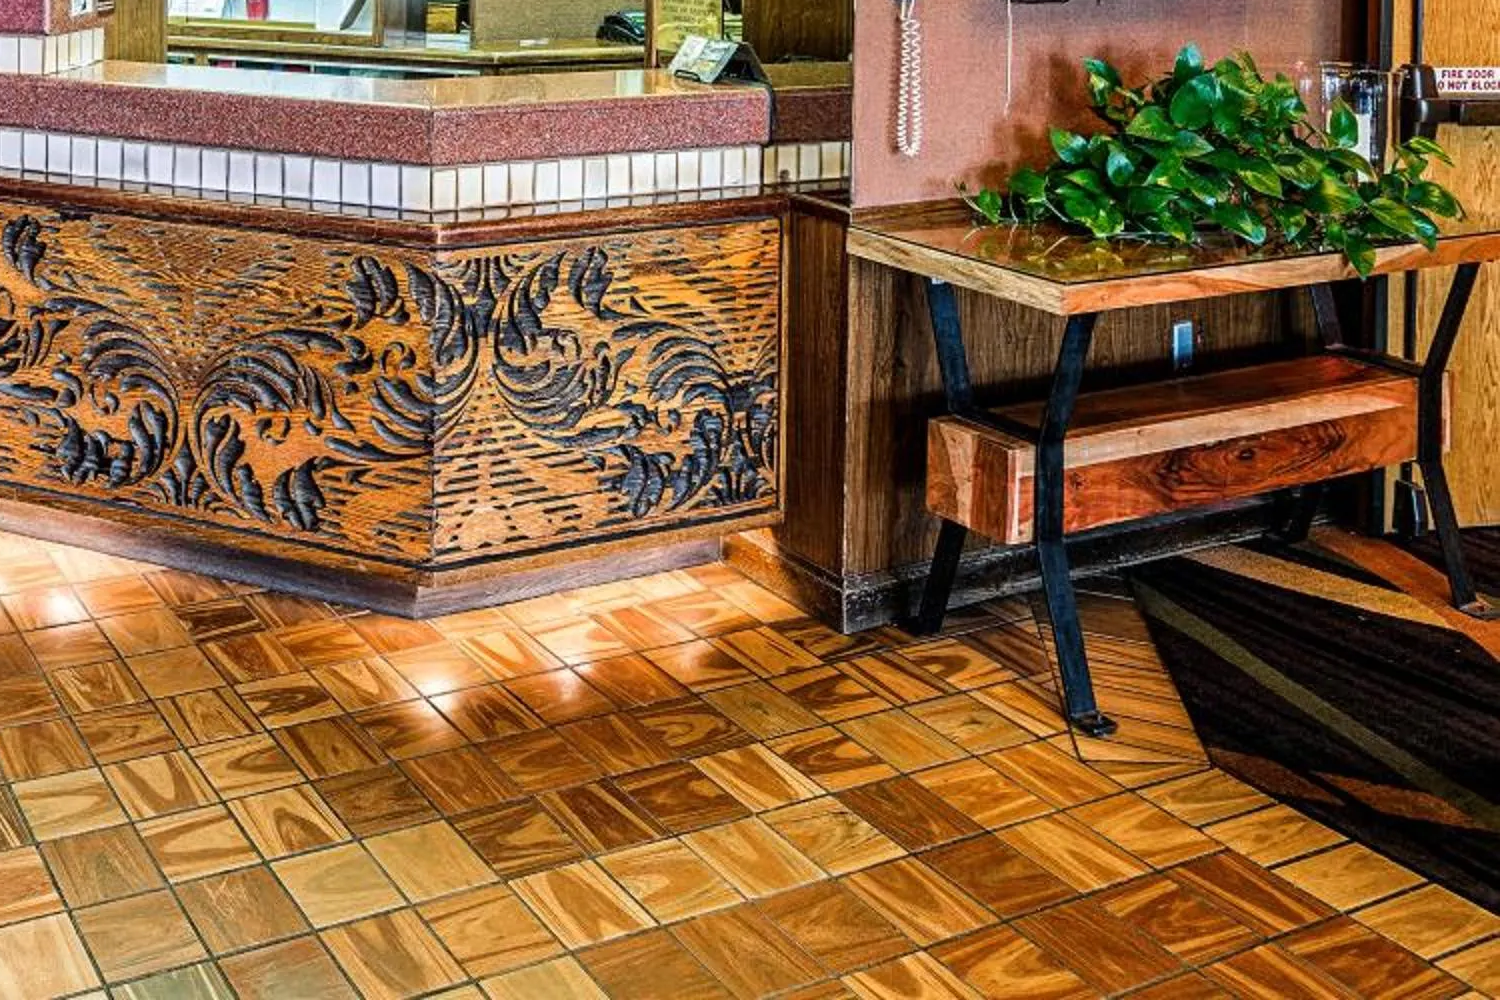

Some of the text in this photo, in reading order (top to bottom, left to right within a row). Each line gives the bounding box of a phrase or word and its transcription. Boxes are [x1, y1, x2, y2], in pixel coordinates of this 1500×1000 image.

[1441, 69, 1495, 79] FIRE DOOR
[1447, 80, 1469, 90] NOT
